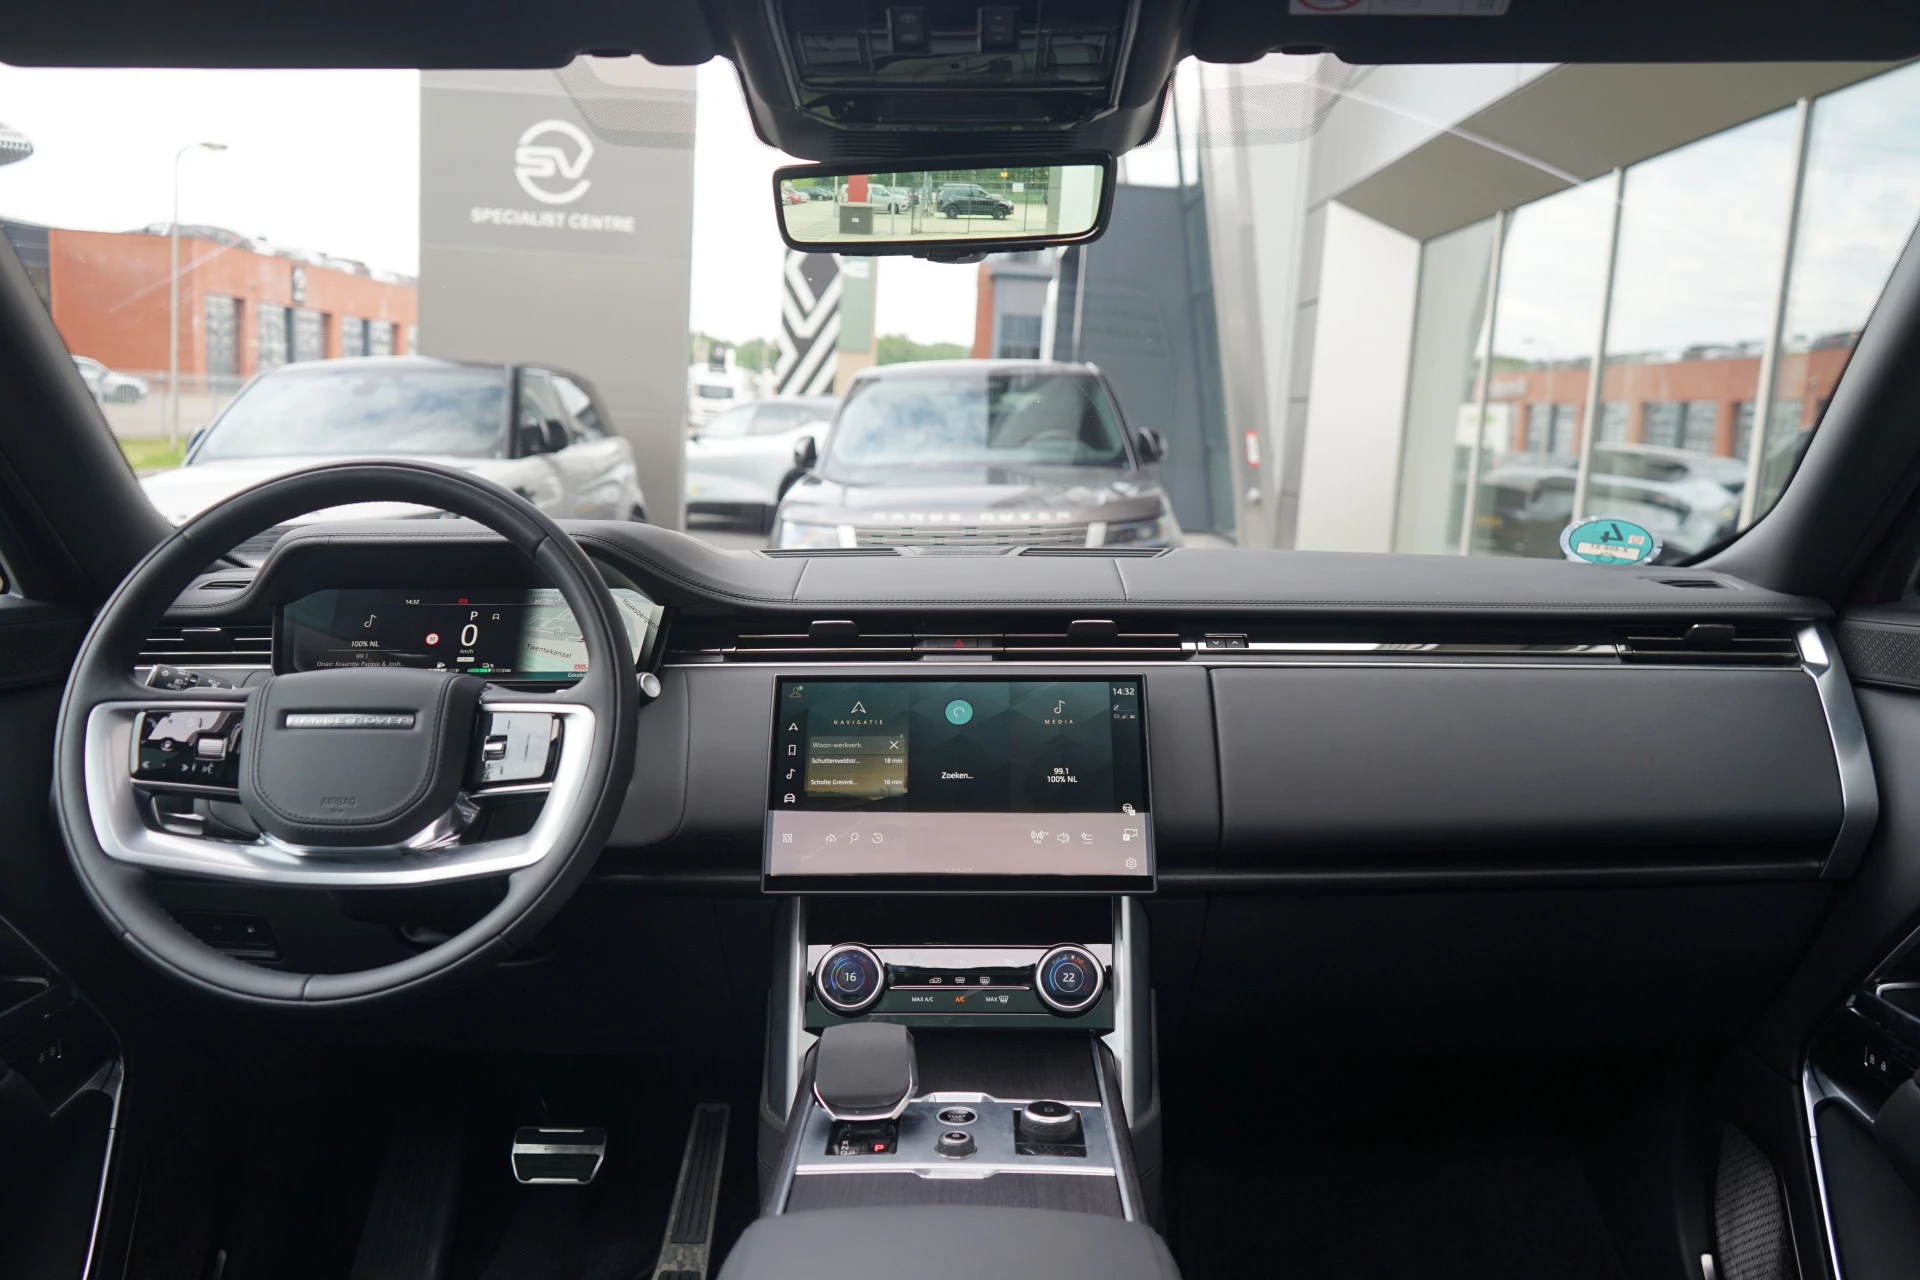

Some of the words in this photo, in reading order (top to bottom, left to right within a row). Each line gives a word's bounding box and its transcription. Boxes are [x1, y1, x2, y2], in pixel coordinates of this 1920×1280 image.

[470, 206, 566, 228] SPECIALIST
[568, 212, 636, 233] CENTRE
[470, 611, 478, 620] P
[461, 624, 478, 646] 0
[526, 642, 572, 659] Twentekanaal
[1112, 687, 1135, 696] 14:32
[287, 714, 345, 726] RANGE
[351, 714, 414, 725] ROVER
[941, 771, 974, 779] Zoeken...
[1053, 767, 1069, 775] 99.1
[1047, 775, 1066, 783] 100%
[1067, 775, 1078, 783] NL
[845, 972, 857, 982] 16
[1062, 972, 1076, 982] 22
[874, 1144, 884, 1152] P
